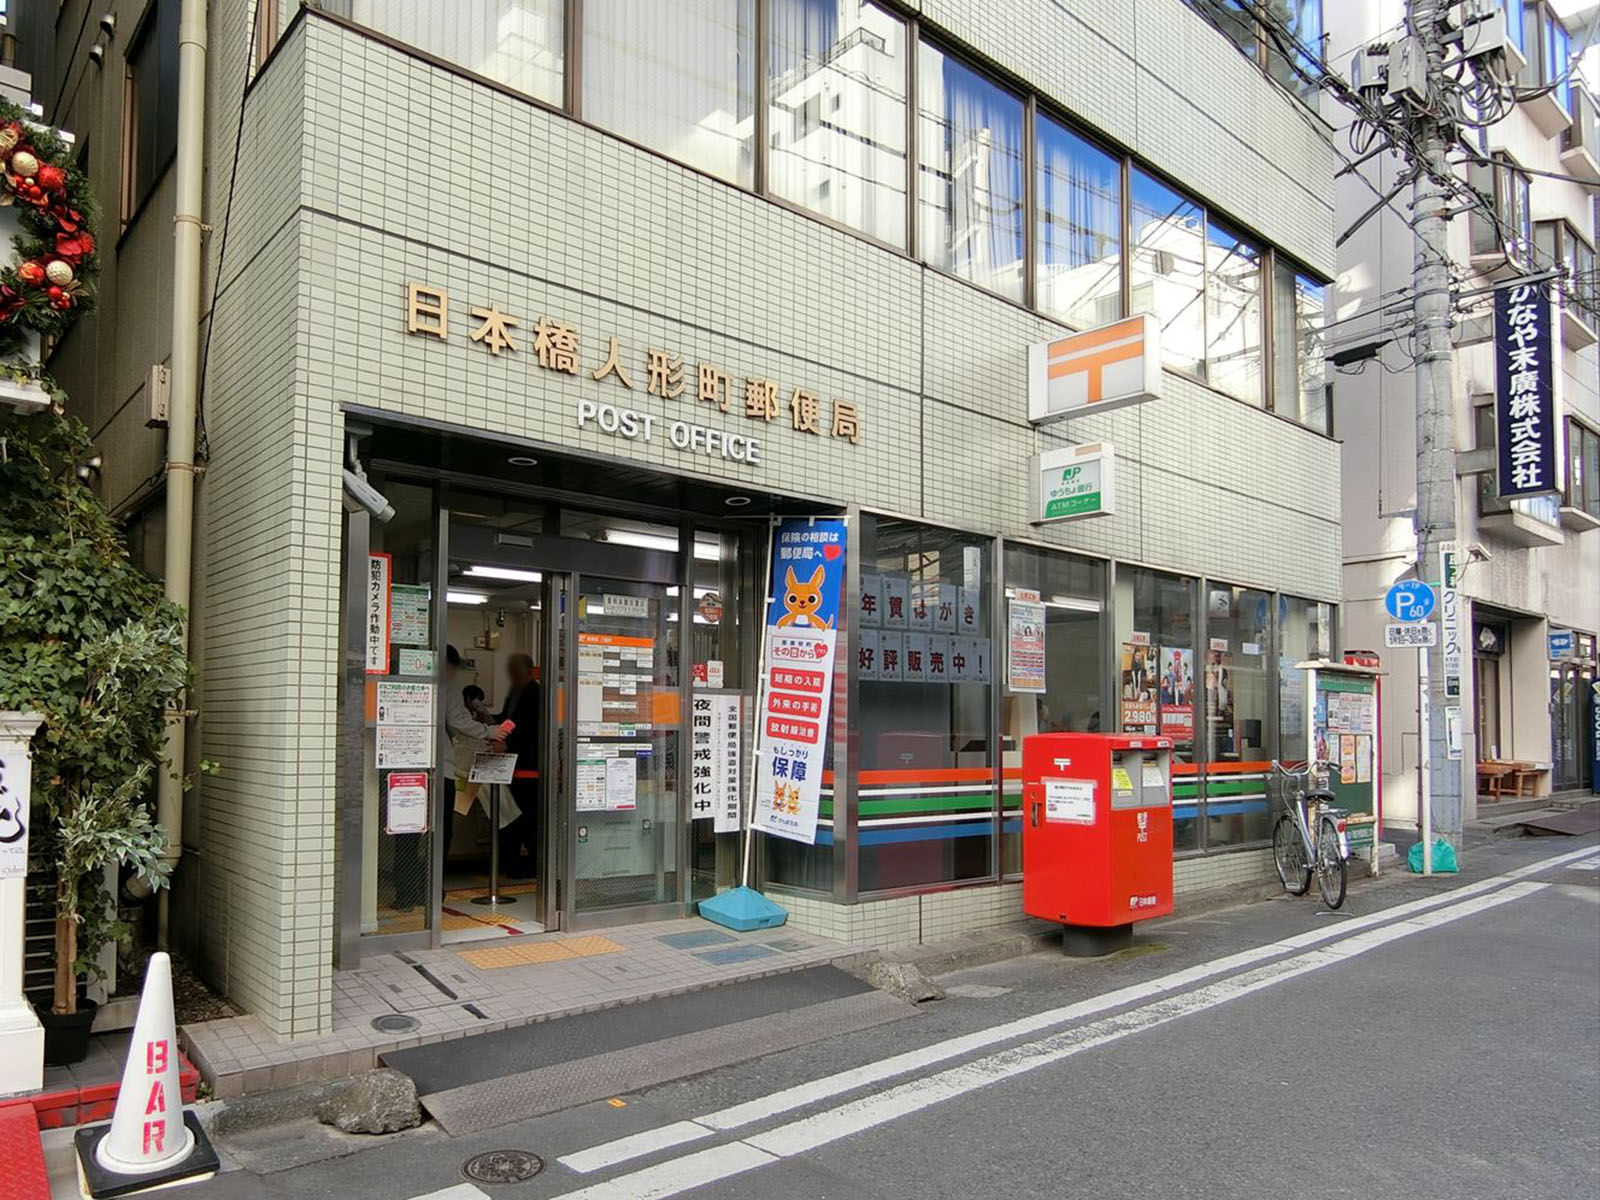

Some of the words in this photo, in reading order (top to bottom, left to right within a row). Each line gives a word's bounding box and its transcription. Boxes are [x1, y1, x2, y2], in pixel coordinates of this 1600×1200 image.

[405, 281, 862, 445] 日本橋人形町郵便局
[577, 398, 656, 441] POST
[669, 421, 762, 465] OFFICE
[369, 559, 382, 666] 防犯カメラ作動中です
[1395, 591, 1415, 618] P
[1409, 605, 1425, 617] 60
[1443, 591, 1459, 656] クリニック
[693, 699, 712, 812] 夜間警戒強化中
[772, 755, 808, 782] 保障
[141, 1039, 169, 1156] BAR
